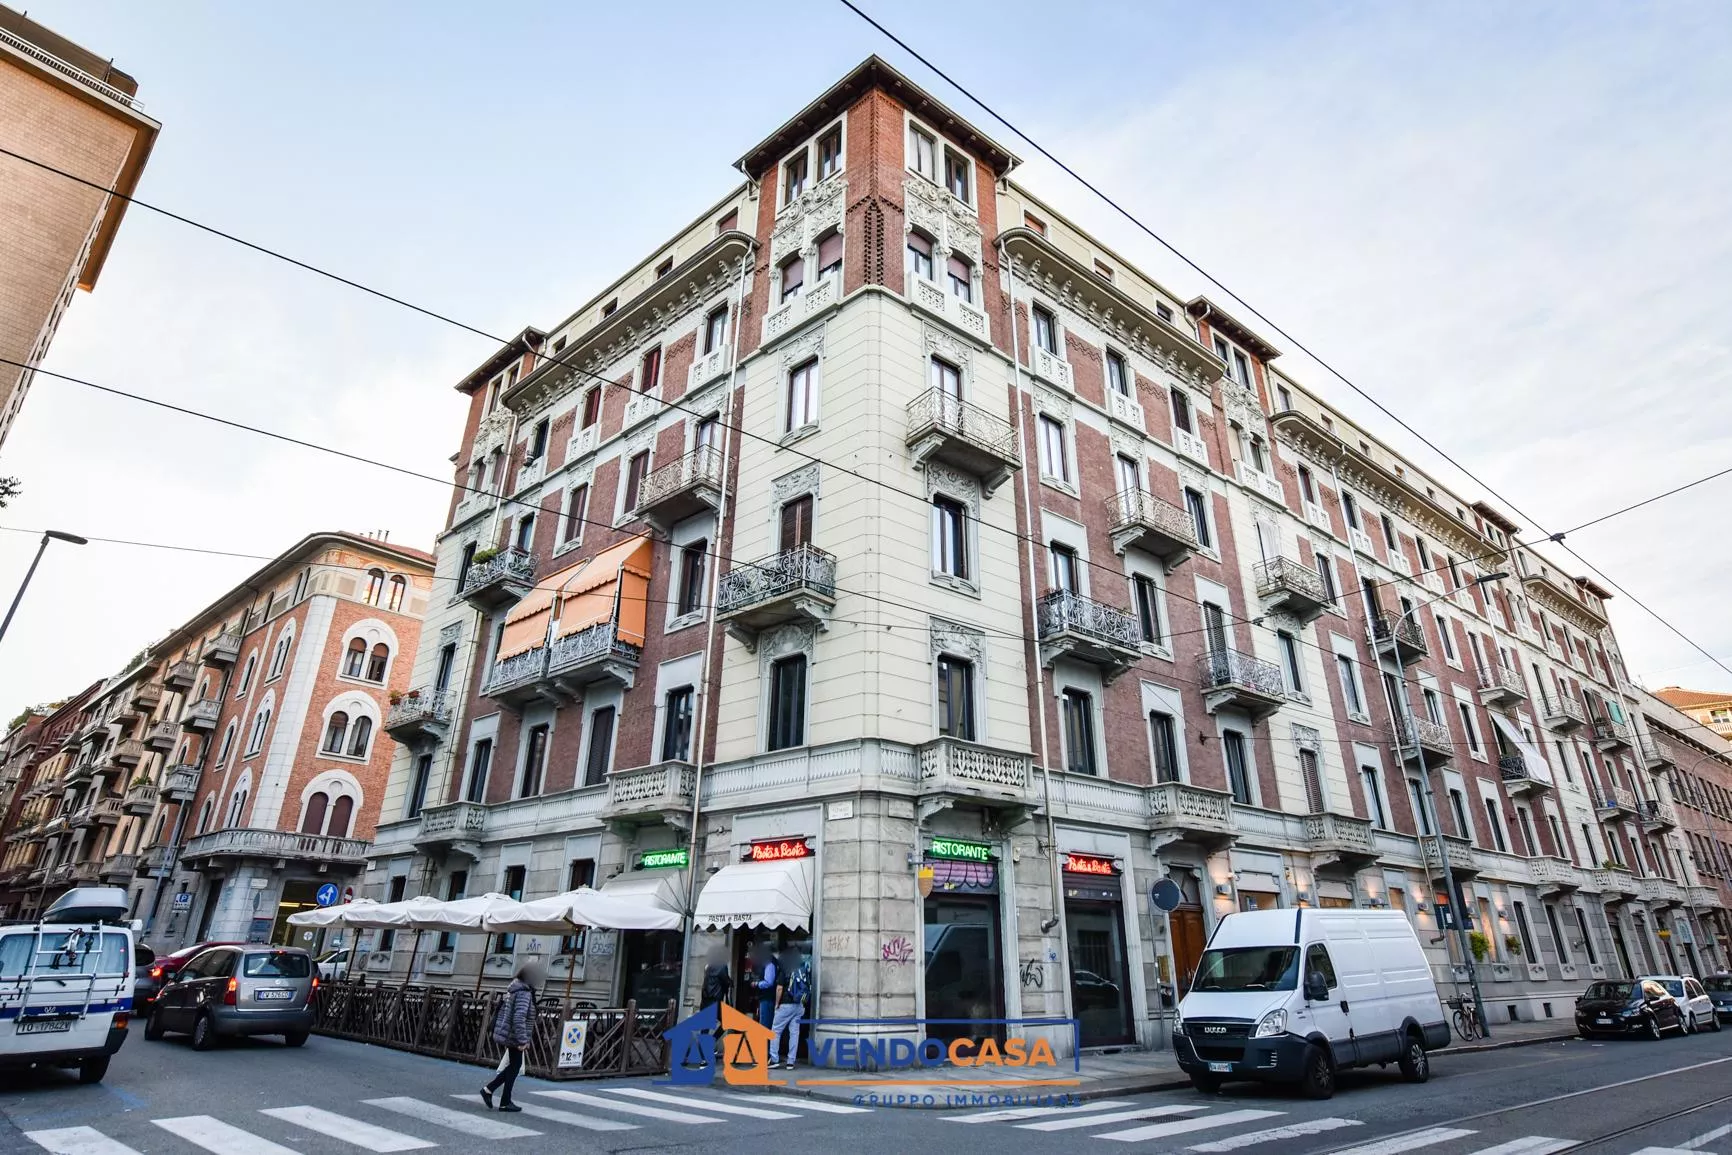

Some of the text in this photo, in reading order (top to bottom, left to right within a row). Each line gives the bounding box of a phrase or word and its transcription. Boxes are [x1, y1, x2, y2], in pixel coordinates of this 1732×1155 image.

[752, 845, 774, 859] Pasta
[780, 843, 805, 857] Basta
[932, 841, 988, 860] RISTORANTE
[644, 852, 686, 866] RISTORANTE
[708, 914, 726, 922] PASTA
[734, 913, 752, 921] BASTA
[21, 1024, 33, 1032] TO
[1204, 1026, 1227, 1034] IVECO
